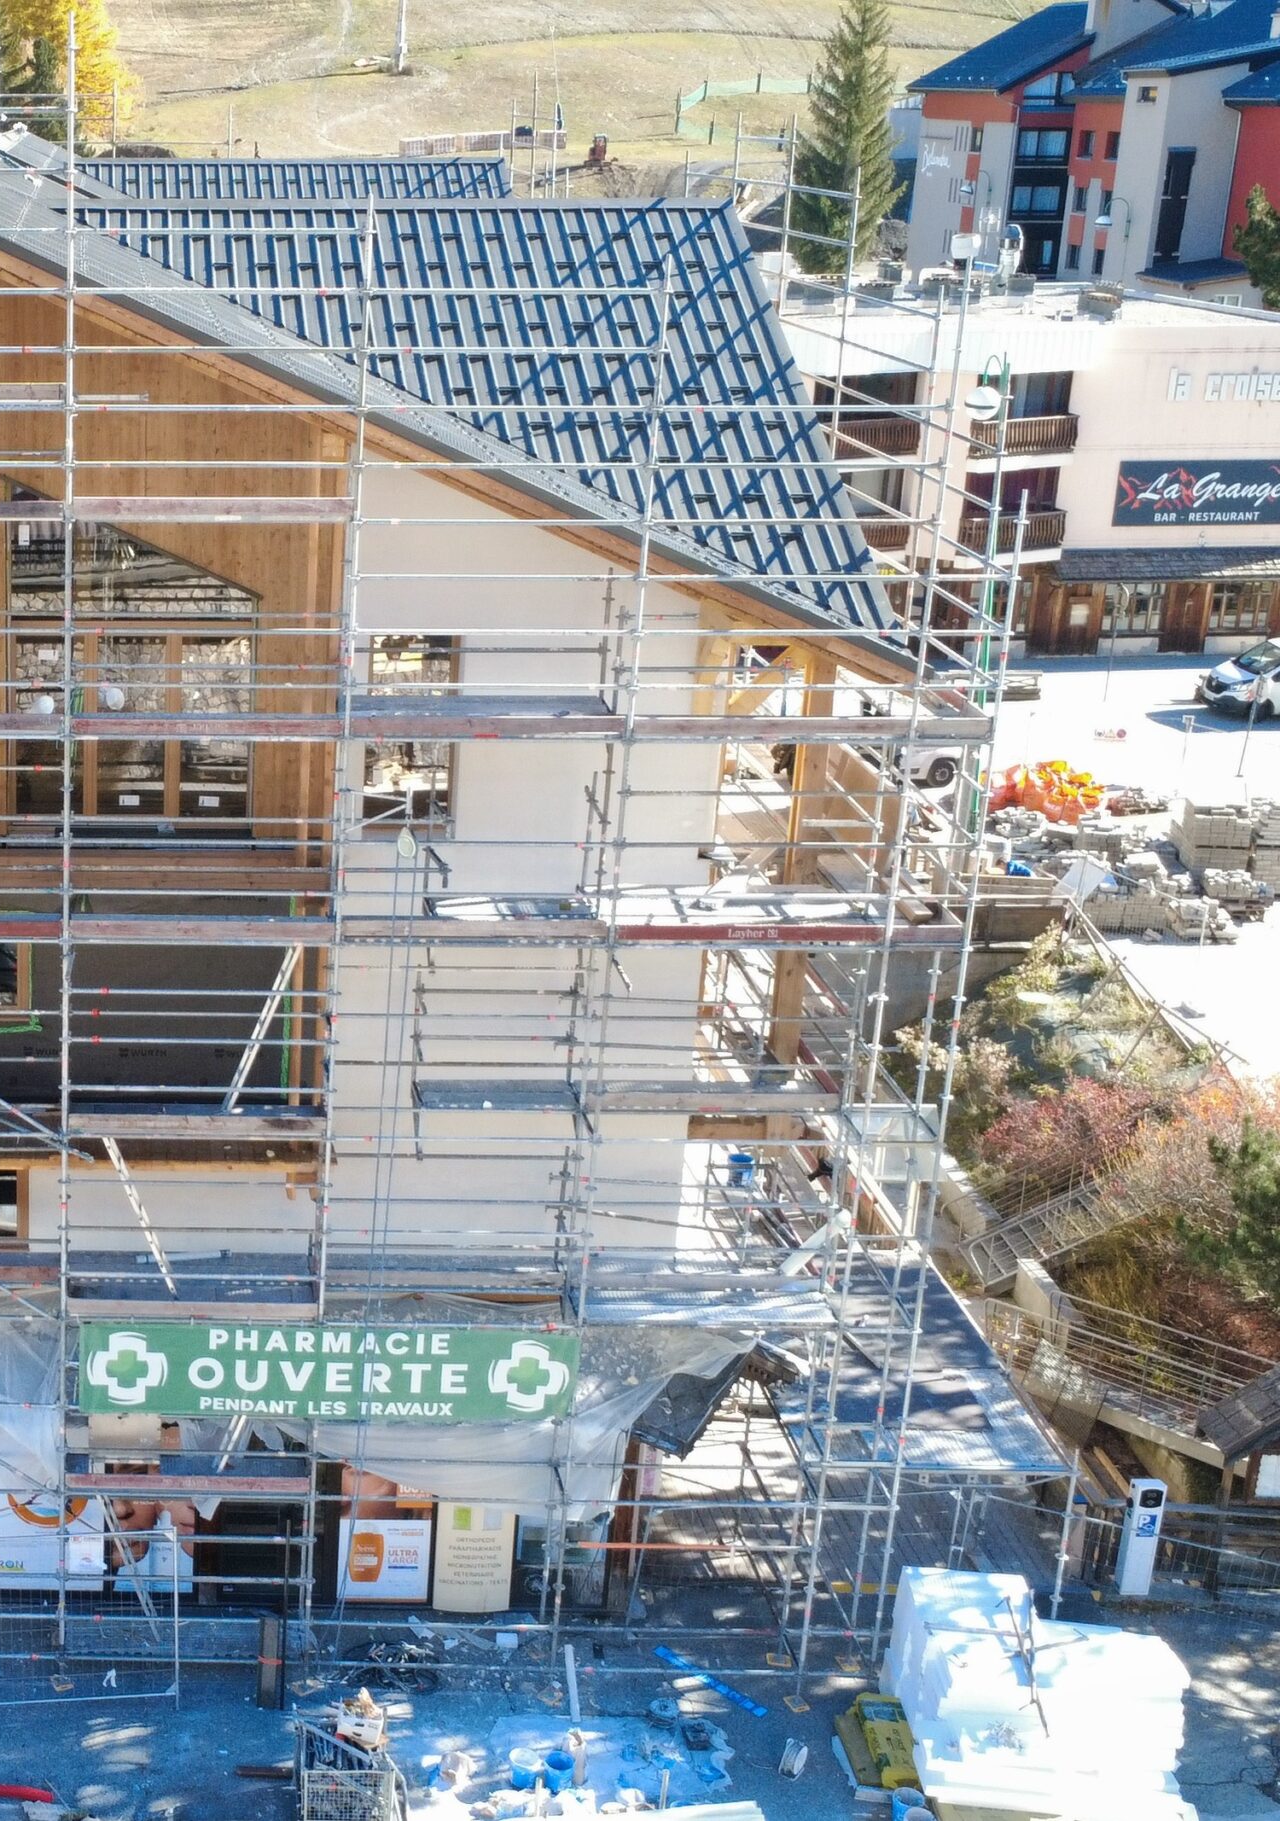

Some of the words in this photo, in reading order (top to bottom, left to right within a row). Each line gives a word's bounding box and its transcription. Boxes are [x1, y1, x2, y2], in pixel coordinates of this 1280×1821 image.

[1166, 367, 1191, 401] la
[1136, 473, 1182, 500] La
[1193, 471, 1280, 508] Grange
[1154, 512, 1177, 522] BAR
[1188, 511, 1261, 522] RESTAURANT
[728, 928, 765, 939] Layher
[209, 1328, 450, 1356] PHARMACIE
[188, 1357, 469, 1394] OUVERTE
[199, 1396, 298, 1415] PENDANT
[308, 1400, 347, 1416] LES
[358, 1401, 453, 1417] TRAVAUX
[387, 1556, 419, 1565] LARGE
[388, 1549, 419, 1557] ULTRA
